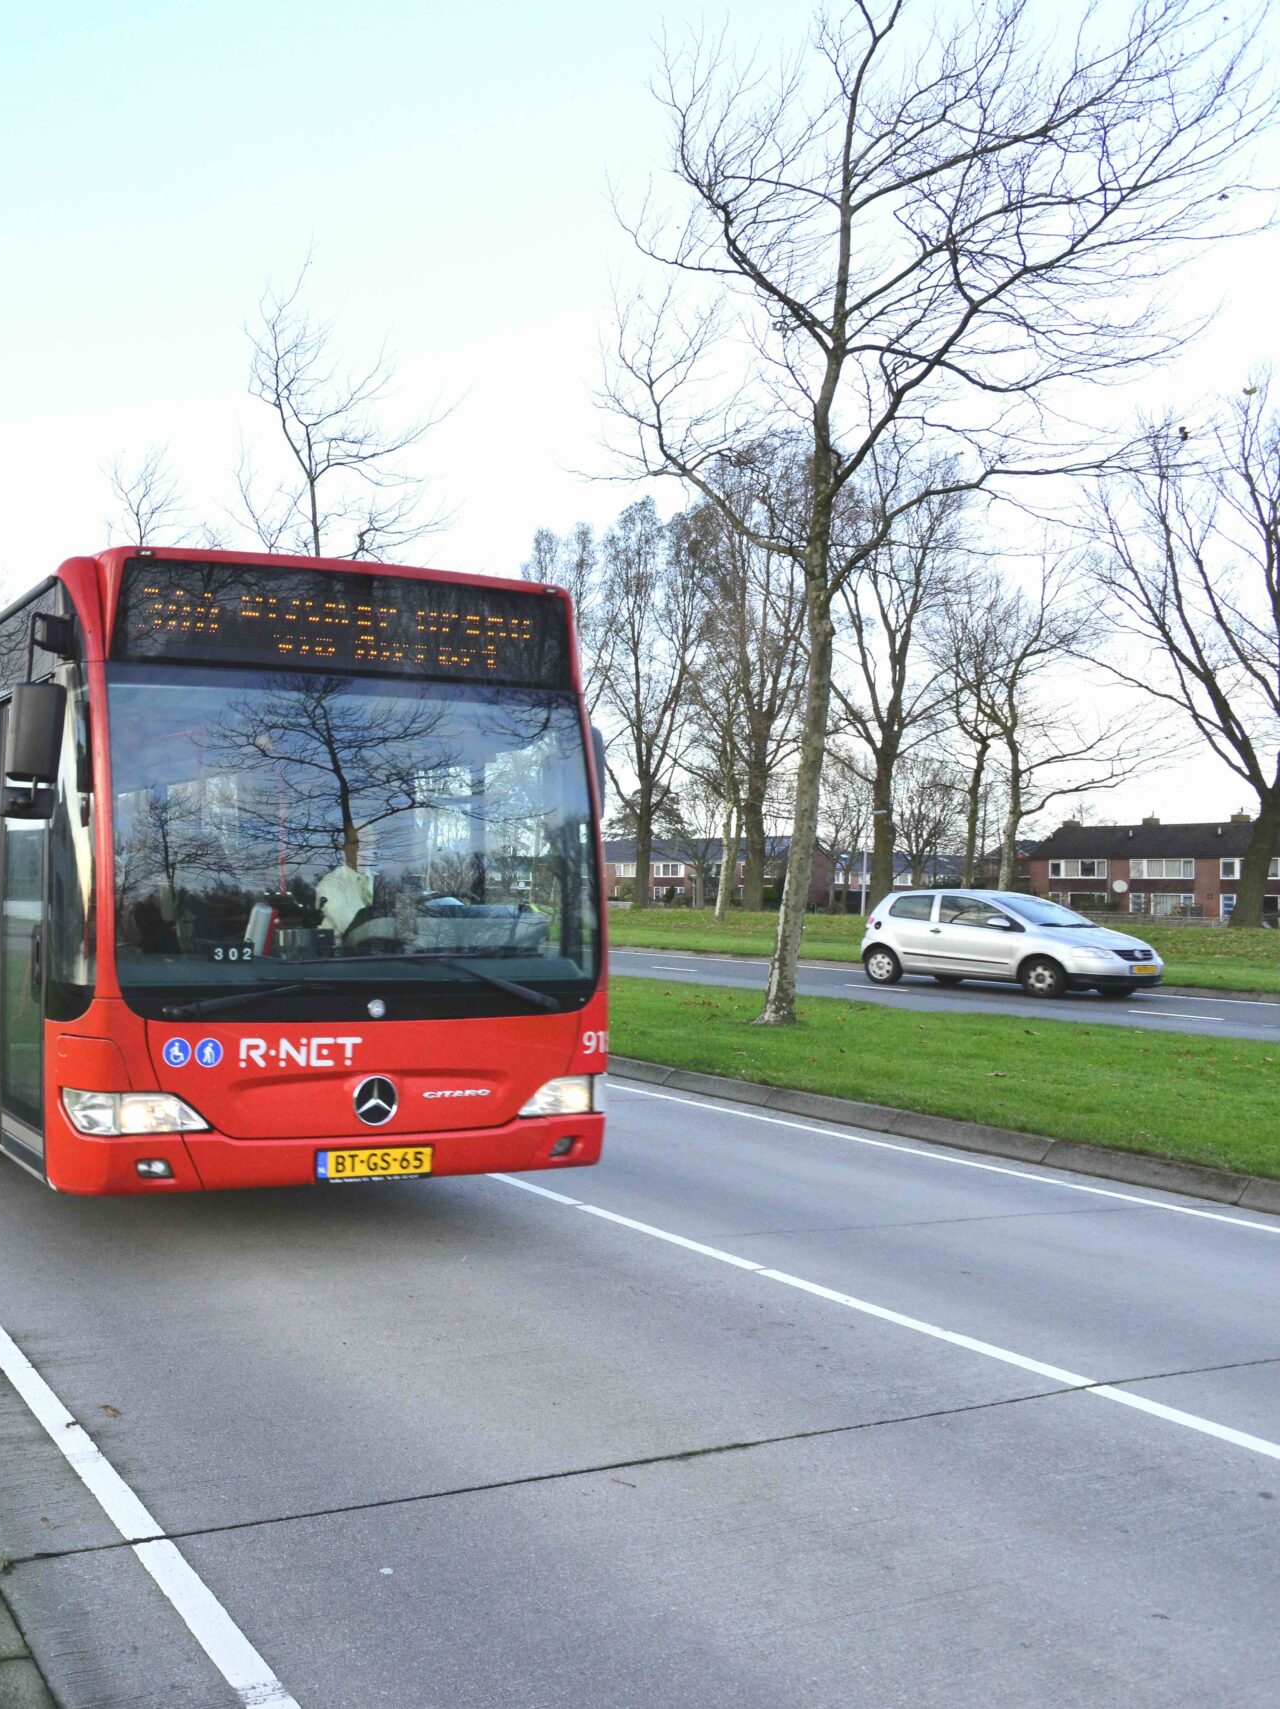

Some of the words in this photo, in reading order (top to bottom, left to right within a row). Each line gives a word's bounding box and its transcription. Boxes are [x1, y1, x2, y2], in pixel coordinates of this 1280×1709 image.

[214, 947, 252, 961] 302
[422, 1089, 491, 1099] CITARO
[335, 1151, 424, 1173] BT-GS-65
